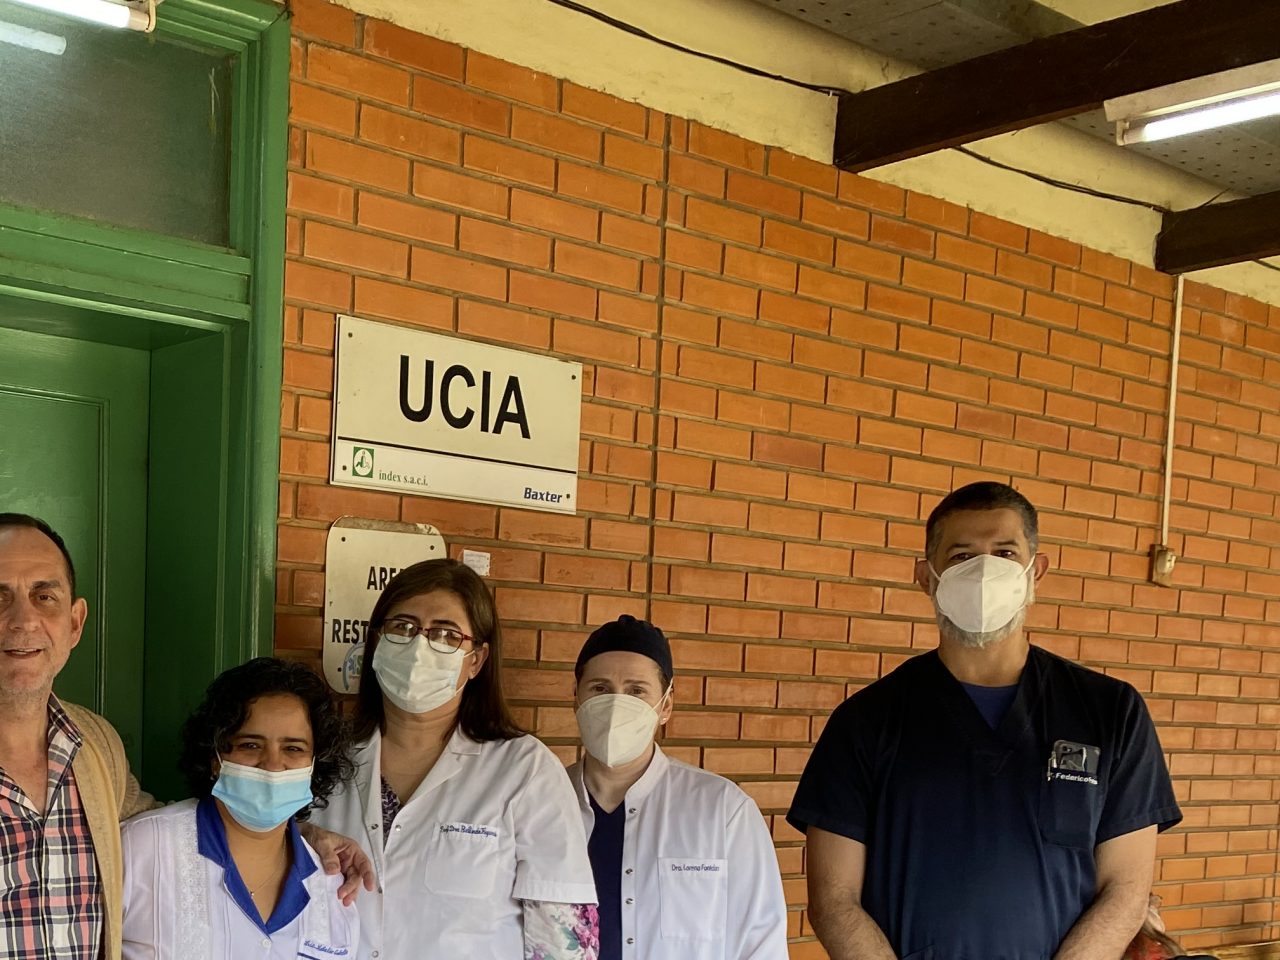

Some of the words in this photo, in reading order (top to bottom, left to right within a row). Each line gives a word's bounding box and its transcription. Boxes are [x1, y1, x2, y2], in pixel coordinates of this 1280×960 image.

[399, 354, 531, 440] UCIA
[378, 469, 401, 483] index
[523, 487, 563, 504] Baxter
[332, 618, 370, 644] REST
